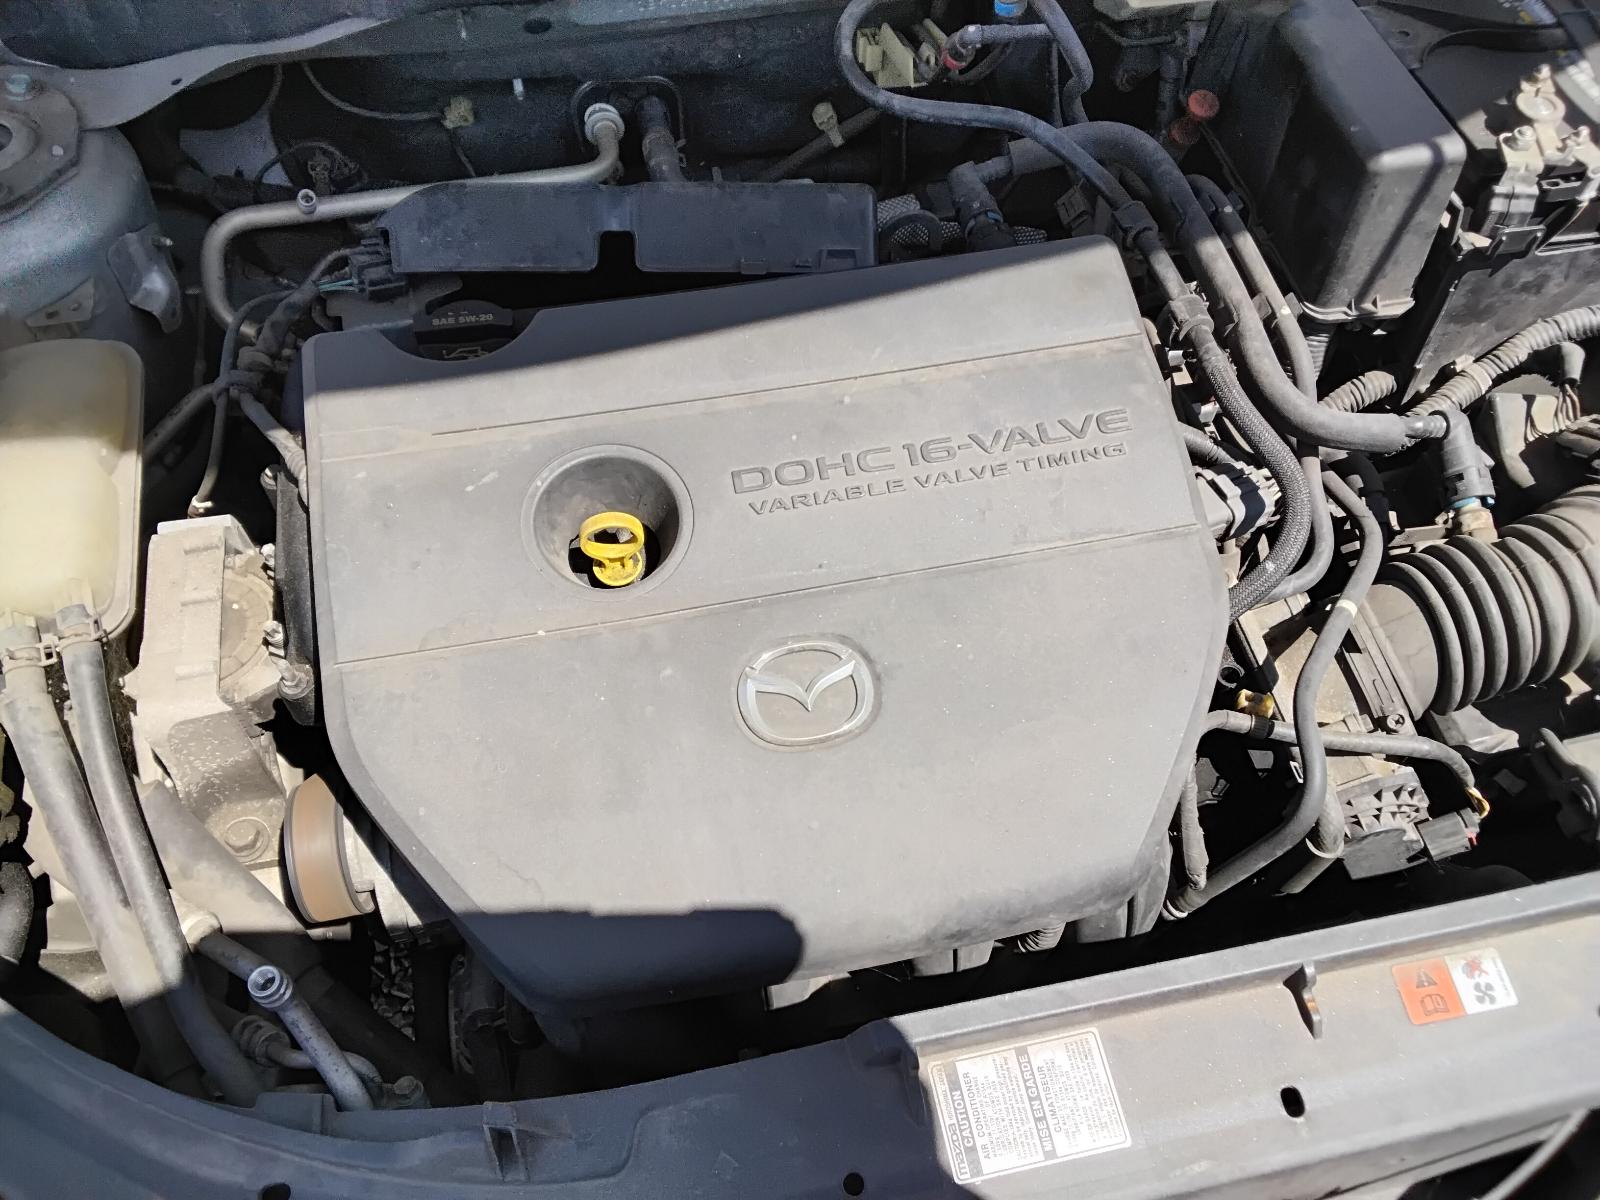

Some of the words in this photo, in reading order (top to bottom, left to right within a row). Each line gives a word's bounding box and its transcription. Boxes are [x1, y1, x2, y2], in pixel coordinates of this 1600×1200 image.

[432, 317, 456, 326] SAE
[458, 313, 494, 324] 5W-20
[730, 446, 896, 495] DOHC
[902, 407, 1134, 467] 16-VALVE
[748, 477, 907, 516] VARIABLE
[913, 461, 1012, 489] VALVE
[1015, 441, 1128, 473] TIMING
[1020, 1053, 1038, 1098] GARDE
[1037, 1065, 1062, 1133] CLIMATISEUR
[951, 1089, 973, 1147] CAUTION
[962, 1071, 985, 1137] CONDITIONER
[1032, 1100, 1043, 1118] EN
[980, 1142, 990, 1160] AIR
[1038, 1119, 1053, 1152] MISE
